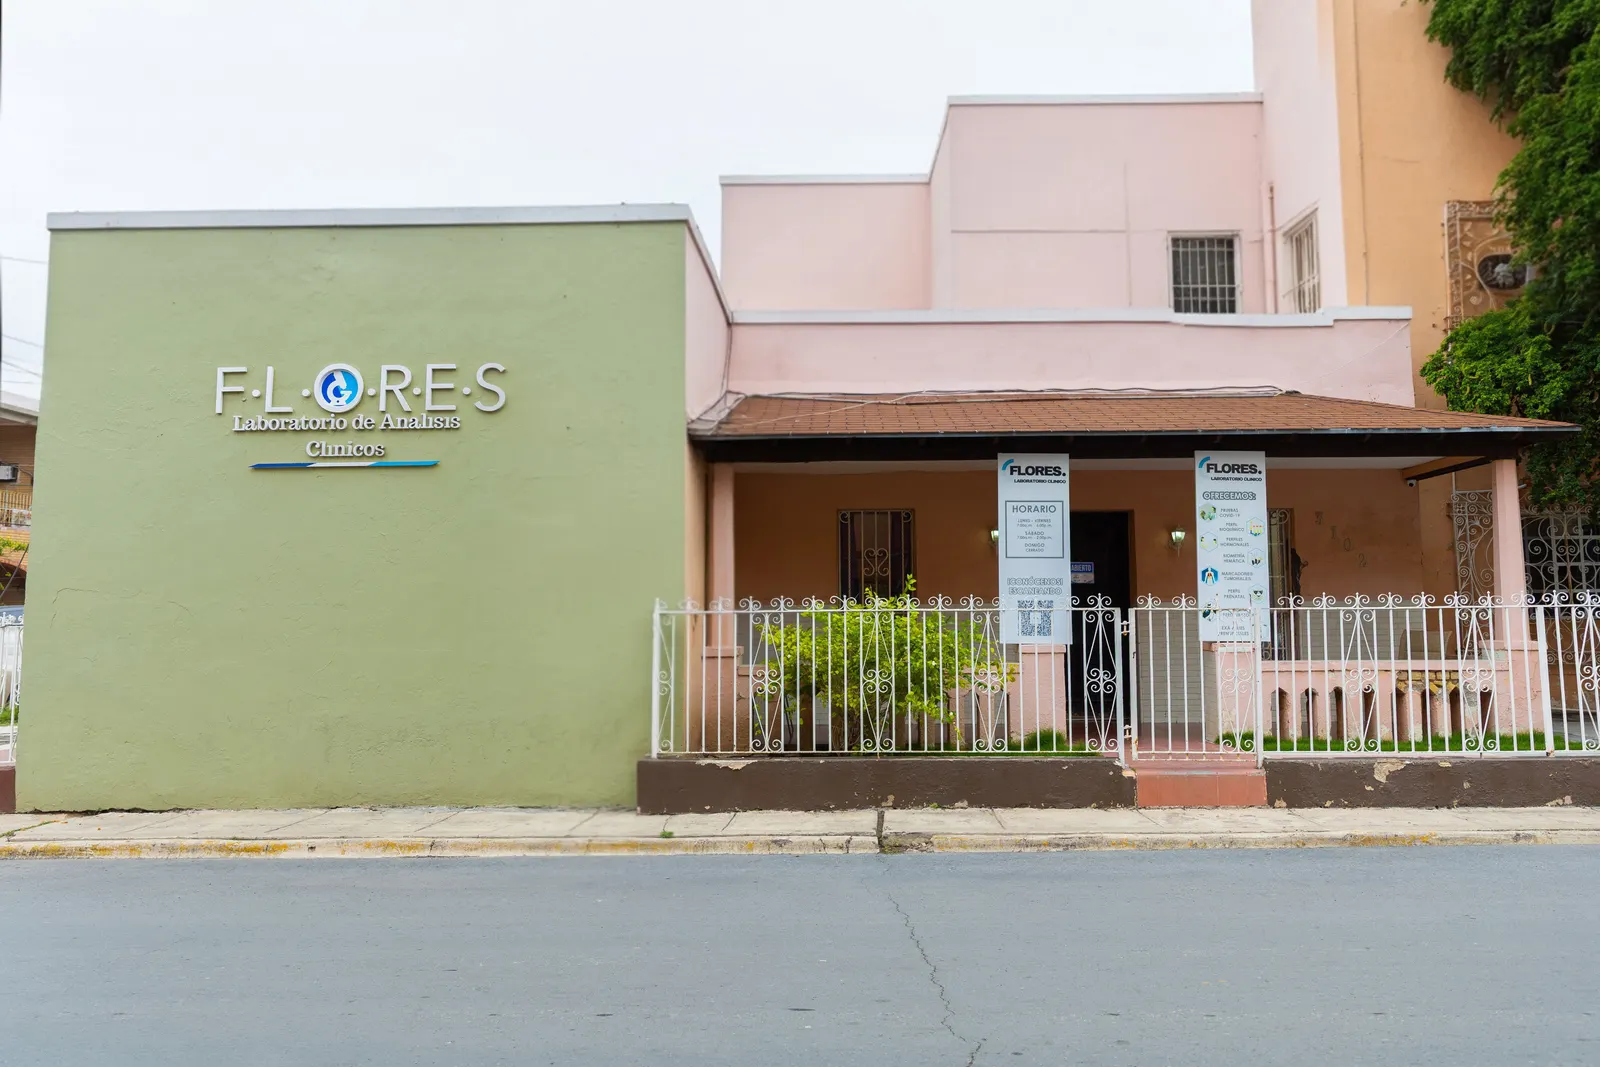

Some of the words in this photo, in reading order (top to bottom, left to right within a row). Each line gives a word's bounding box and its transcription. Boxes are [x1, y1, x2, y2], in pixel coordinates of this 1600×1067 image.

[232, 413, 348, 431] Laboratorio
[352, 413, 375, 430] de
[1010, 465, 1067, 477] FLORES.
[1206, 463, 1263, 475] FLORES.
[1202, 490, 1257, 500] OFRECEMOS:
[1012, 504, 1057, 513] HORARIO
[1008, 587, 1062, 595] ESCANEANDO
